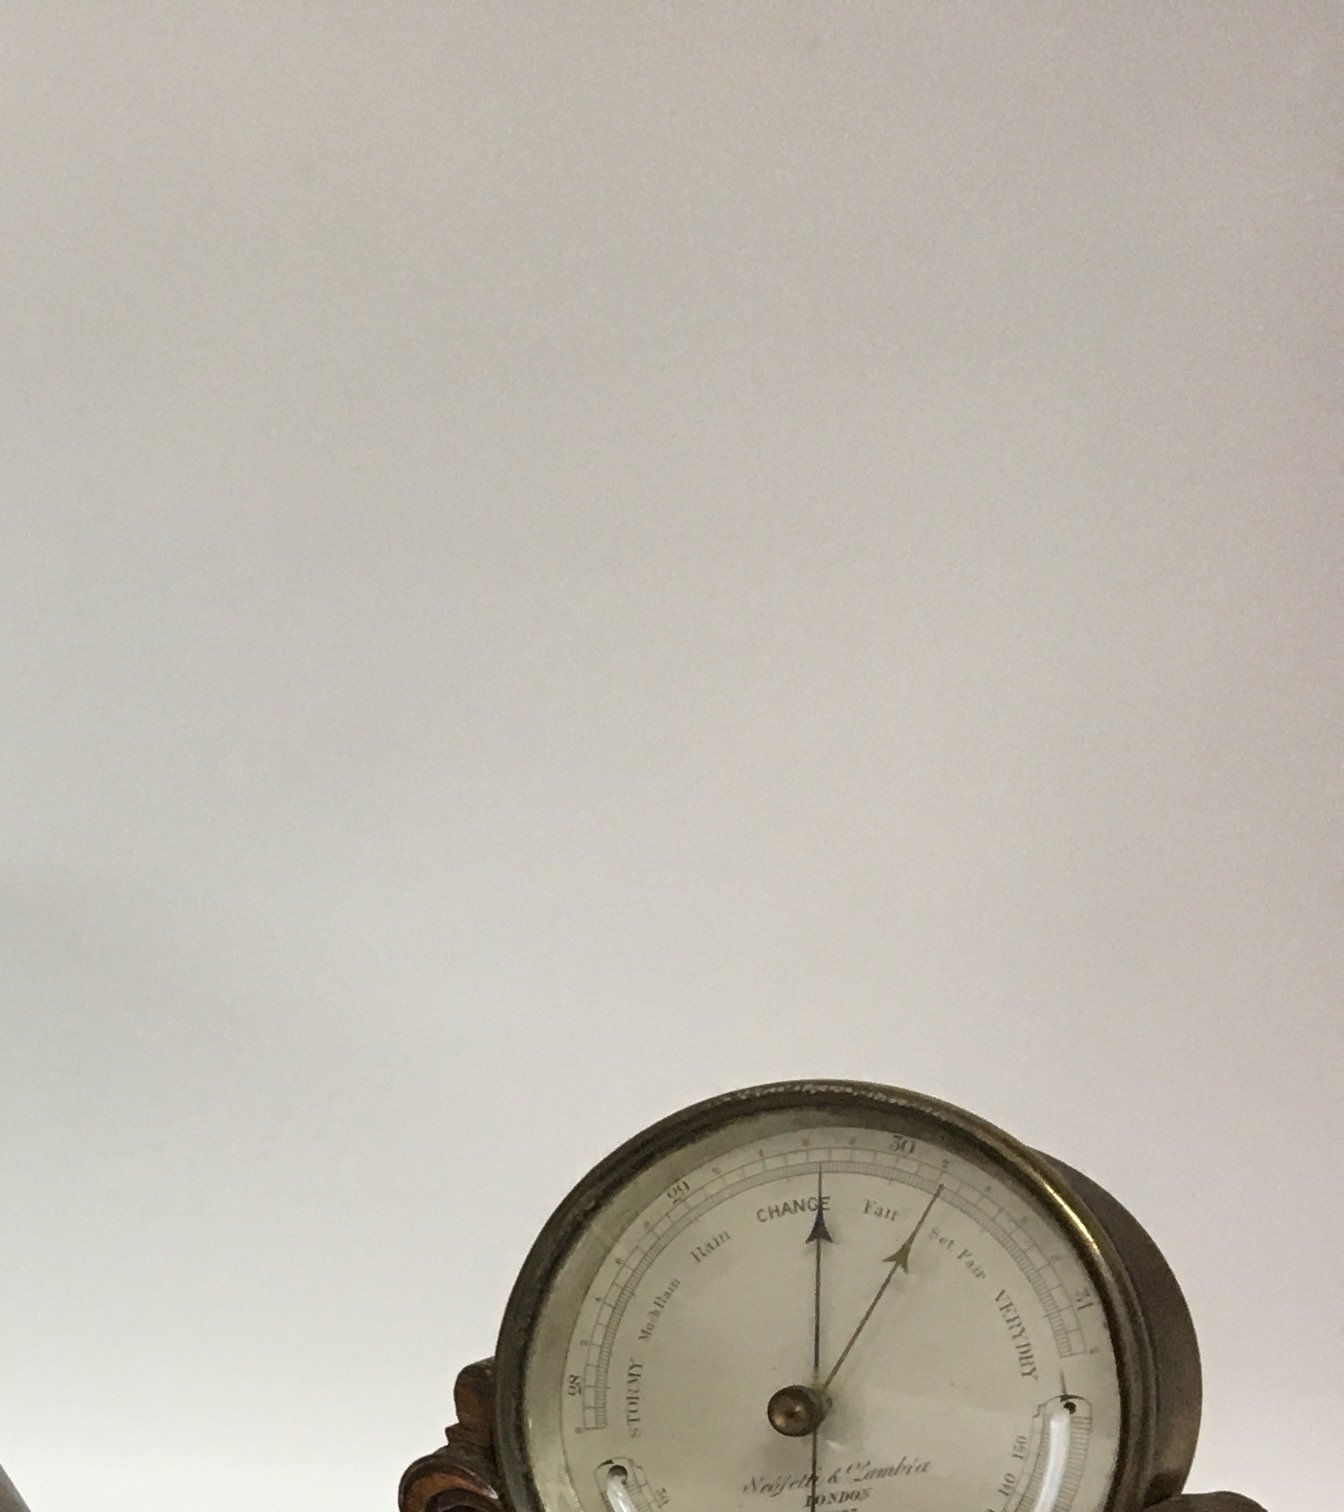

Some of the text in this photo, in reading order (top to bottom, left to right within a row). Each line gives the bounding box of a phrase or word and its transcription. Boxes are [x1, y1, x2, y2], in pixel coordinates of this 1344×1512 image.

[756, 1196, 832, 1224] CHANGE
[862, 1198, 900, 1222] Fair
[689, 1229, 733, 1265] Rain
[928, 1226, 955, 1251] Set
[994, 1288, 1040, 1382] VERY DRY
[625, 1356, 644, 1439] STORMY
[827, 1467, 843, 1484] &
[803, 1486, 875, 1508] LONDON
